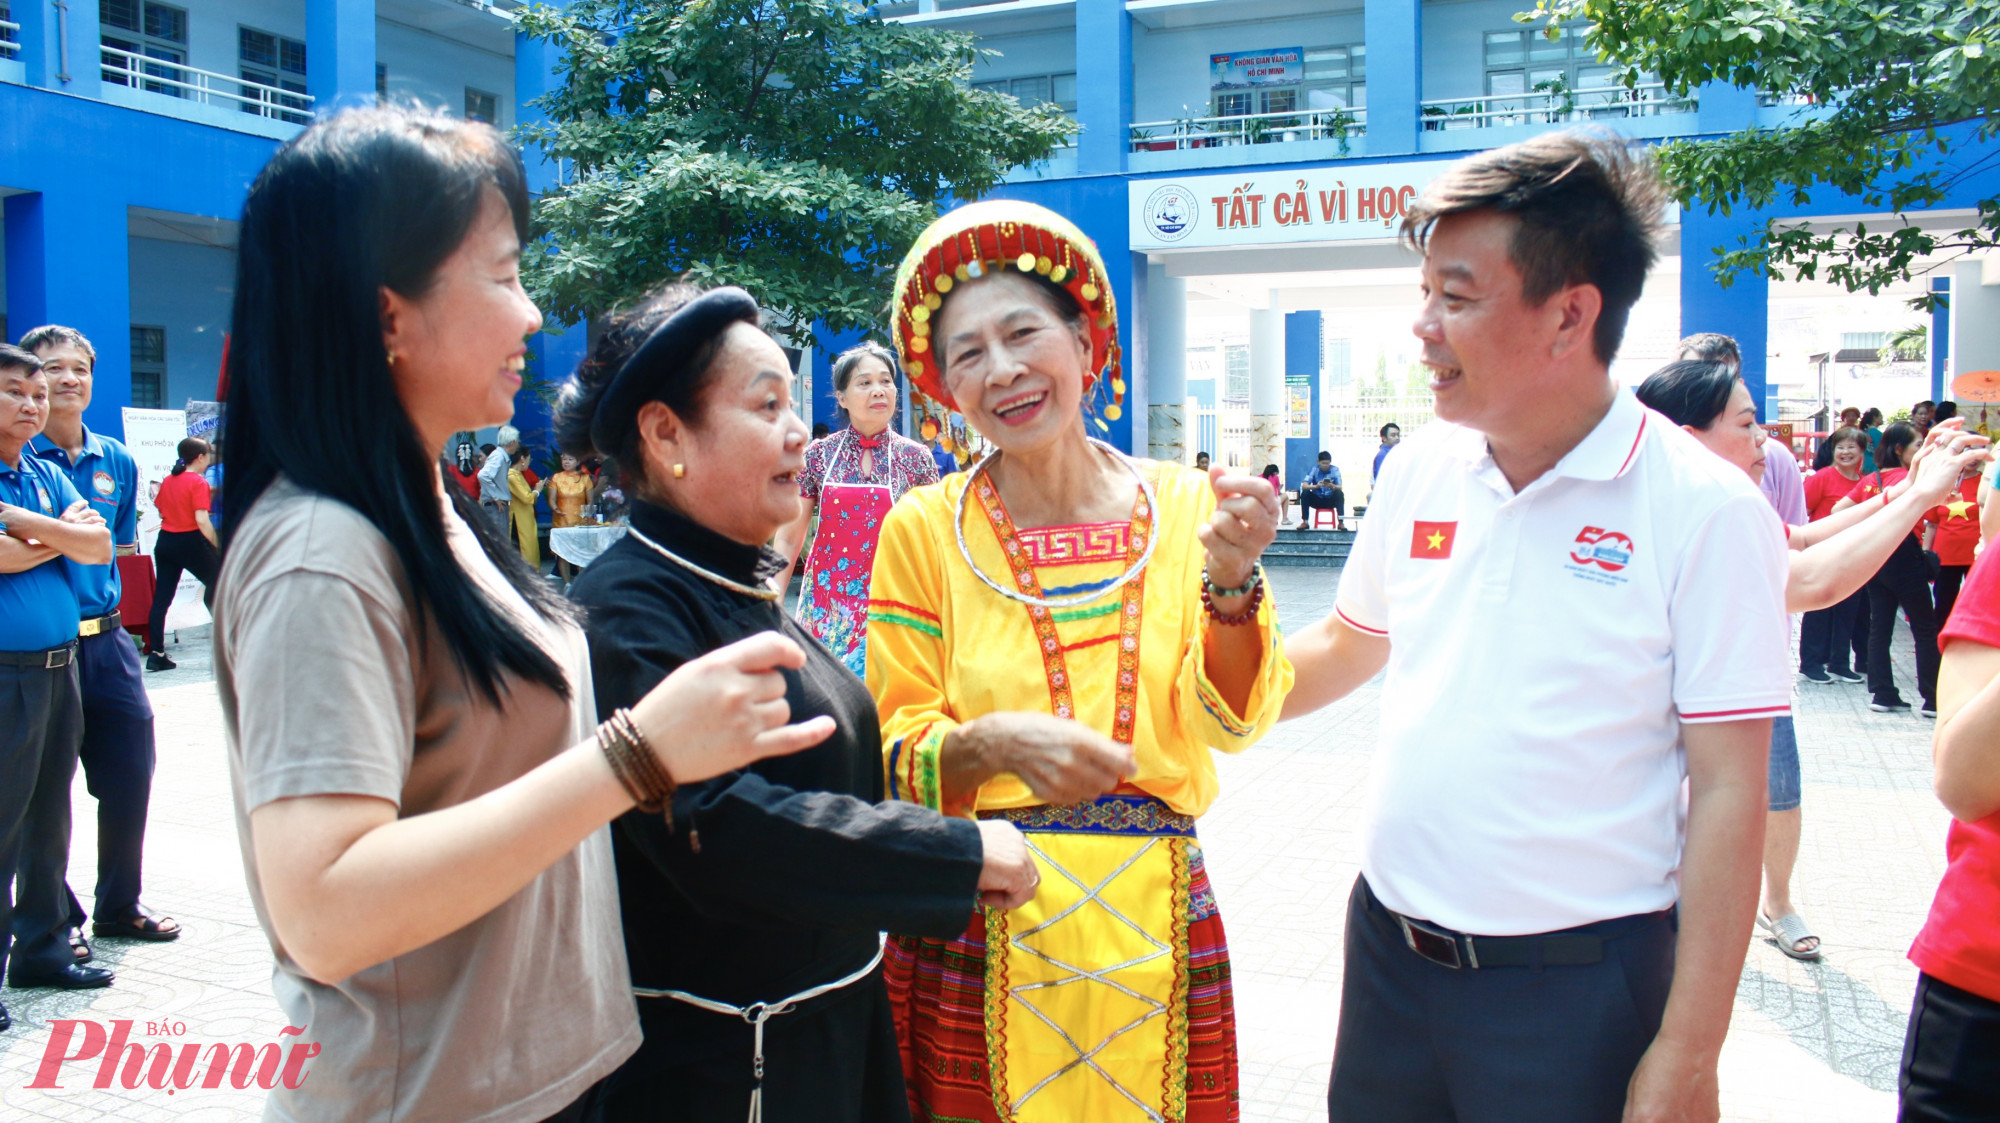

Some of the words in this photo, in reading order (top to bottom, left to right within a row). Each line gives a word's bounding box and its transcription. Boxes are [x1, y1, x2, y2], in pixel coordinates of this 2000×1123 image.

[1234, 58, 1254, 66] KHÔNG
[1256, 56, 1270, 64] GIAN
[1271, 54, 1284, 63] VĂN
[1248, 67, 1256, 76] HỒ
[1257, 68, 1266, 76] CHÍ
[1268, 67, 1284, 75] MINH
[1212, 182, 1264, 228] TẤT
[1273, 179, 1311, 226] CẢ
[1319, 181, 1349, 222] VÌ
[1358, 185, 1416, 228] HỌC
